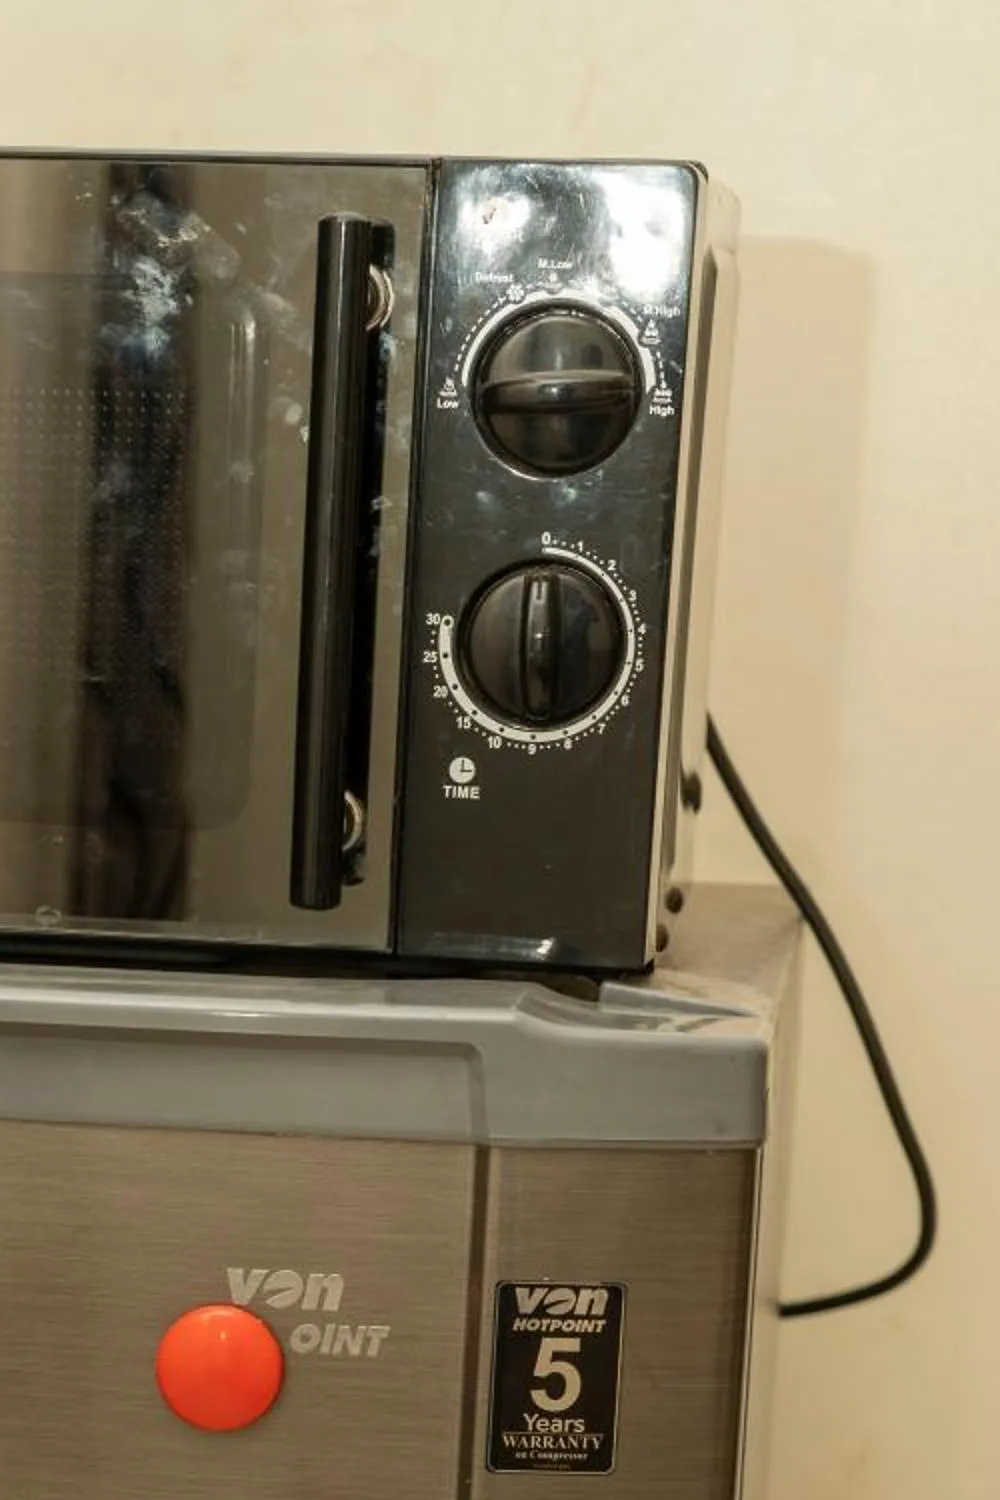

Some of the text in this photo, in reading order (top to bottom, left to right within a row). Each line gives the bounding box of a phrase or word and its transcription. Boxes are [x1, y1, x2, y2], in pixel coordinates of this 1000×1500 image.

[437, 399, 459, 409] Low
[649, 405, 675, 416] High
[608, 559, 616, 571] 2
[630, 590, 636, 601] 3
[425, 613, 440, 625] 30
[637, 623, 646, 635] 4
[423, 651, 437, 663] 25
[636, 660, 643, 672] 5
[433, 685, 448, 698] 20
[621, 694, 629, 706] 6
[456, 717, 471, 729] 15
[599, 724, 606, 735] 7
[488, 737, 502, 749] 10
[527, 744, 537, 756] 9
[443, 785, 480, 800] TIME
[512, 1317, 606, 1333] HOTPOINT
[290, 1323, 391, 1357] OINT
[530, 1337, 582, 1412] 5
[523, 1412, 585, 1434] Years
[503, 1434, 604, 1450] WARRANTY
